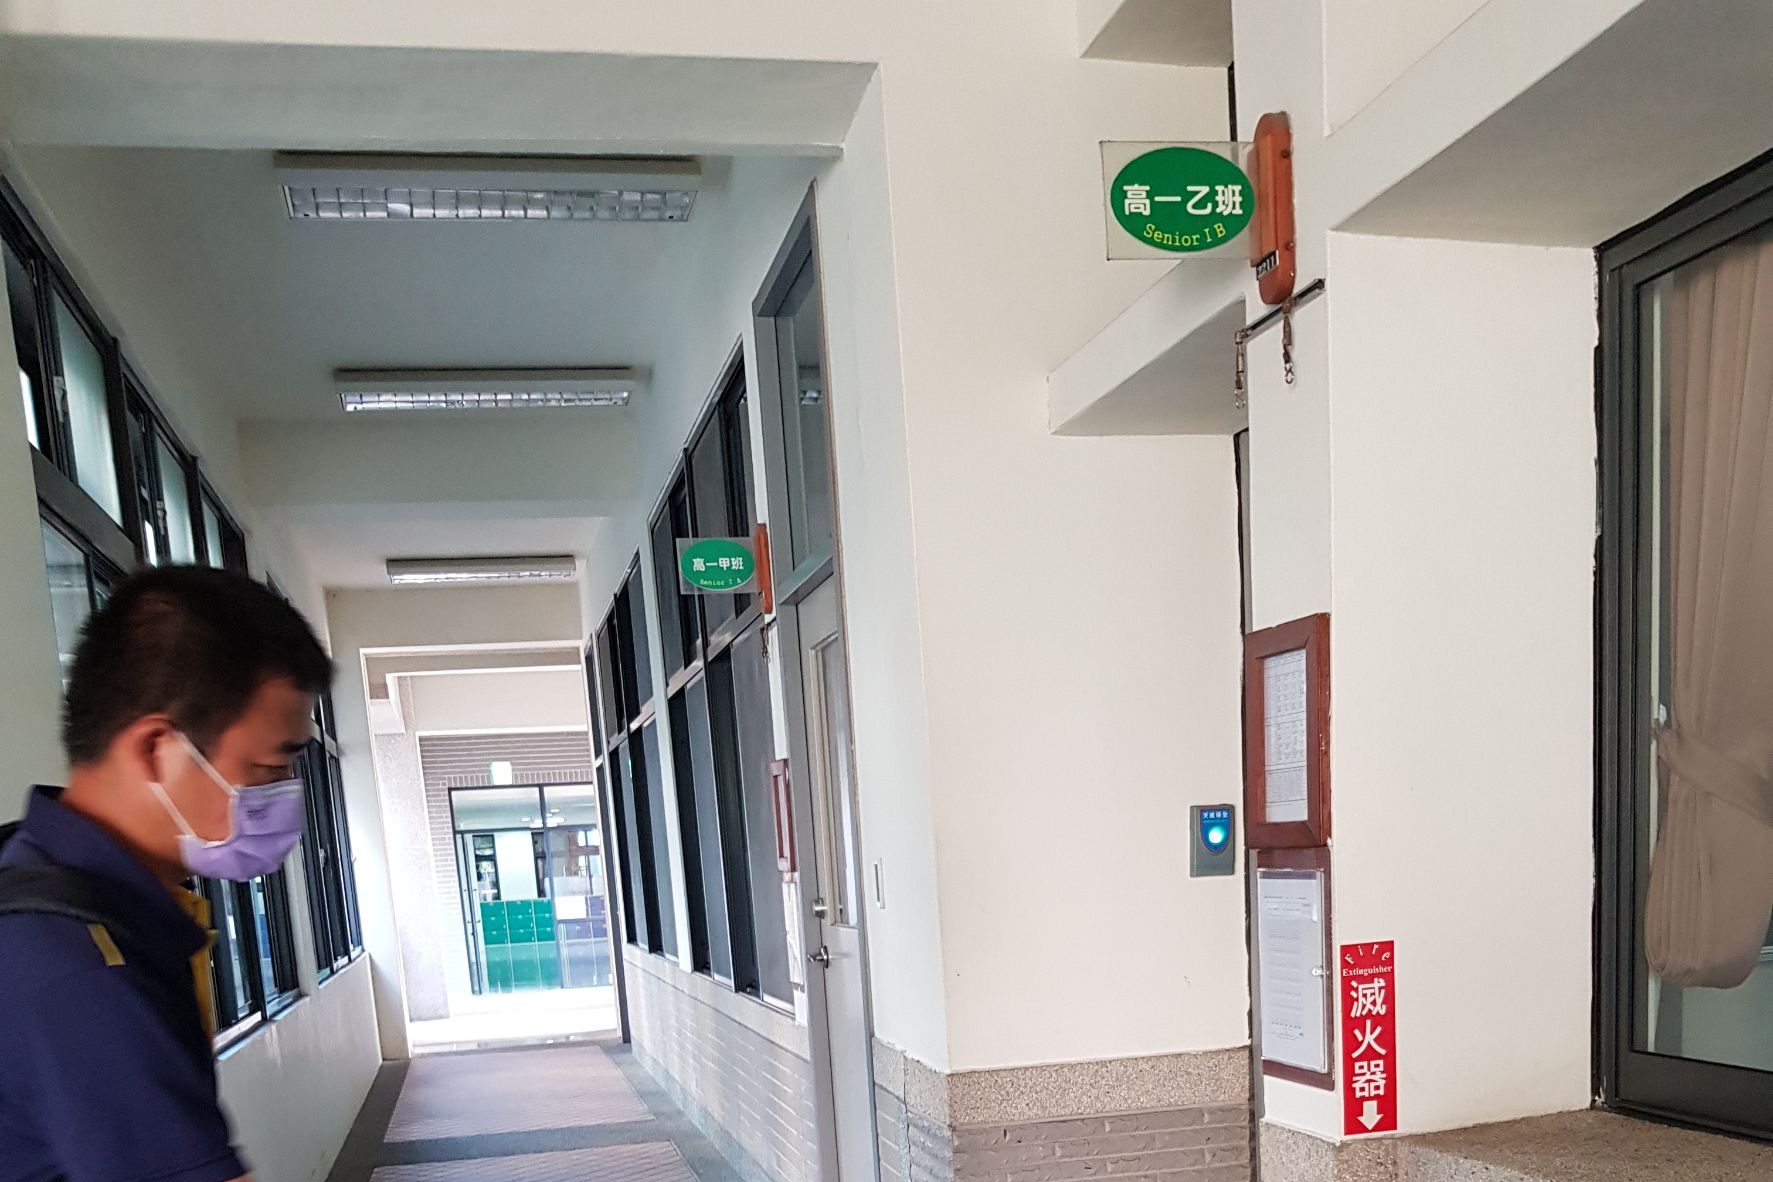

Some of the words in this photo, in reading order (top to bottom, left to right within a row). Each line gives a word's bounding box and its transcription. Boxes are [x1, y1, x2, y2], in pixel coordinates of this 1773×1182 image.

[1123, 184, 1243, 216] 高一乙班
[1143, 223, 1200, 246] Senior
[1214, 223, 1226, 238] B
[692, 557, 744, 572] 高一甲班
[1344, 944, 1391, 965] Fire
[1342, 965, 1392, 977] Extinguisher
[1350, 977, 1387, 1099] 滅火器
